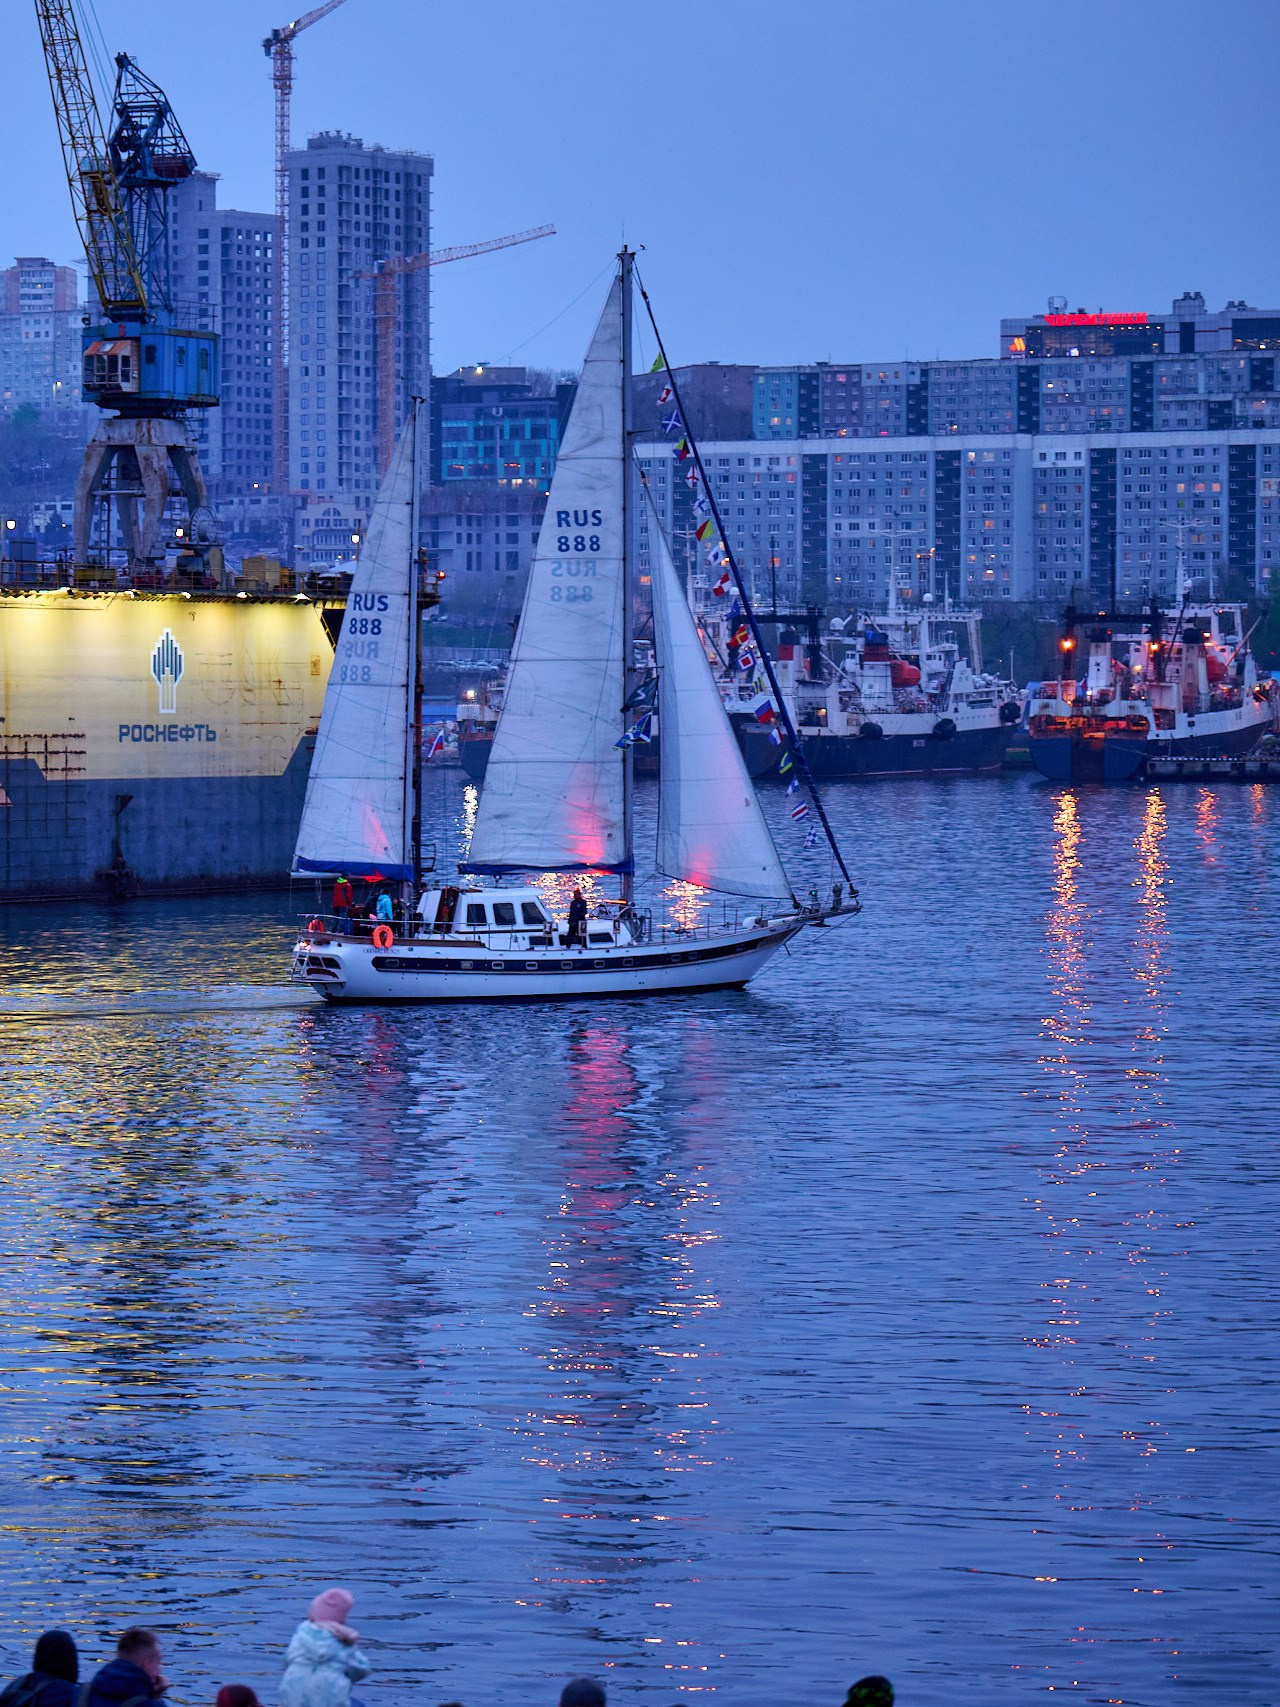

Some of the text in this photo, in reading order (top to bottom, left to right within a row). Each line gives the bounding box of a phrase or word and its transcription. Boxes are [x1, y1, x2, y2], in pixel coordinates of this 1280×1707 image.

[556, 509, 603, 528] RUS
[557, 534, 601, 552] 888
[353, 593, 389, 612] RUS
[349, 617, 382, 636] 888
[118, 724, 217, 742] РОСНЕФТЬ
